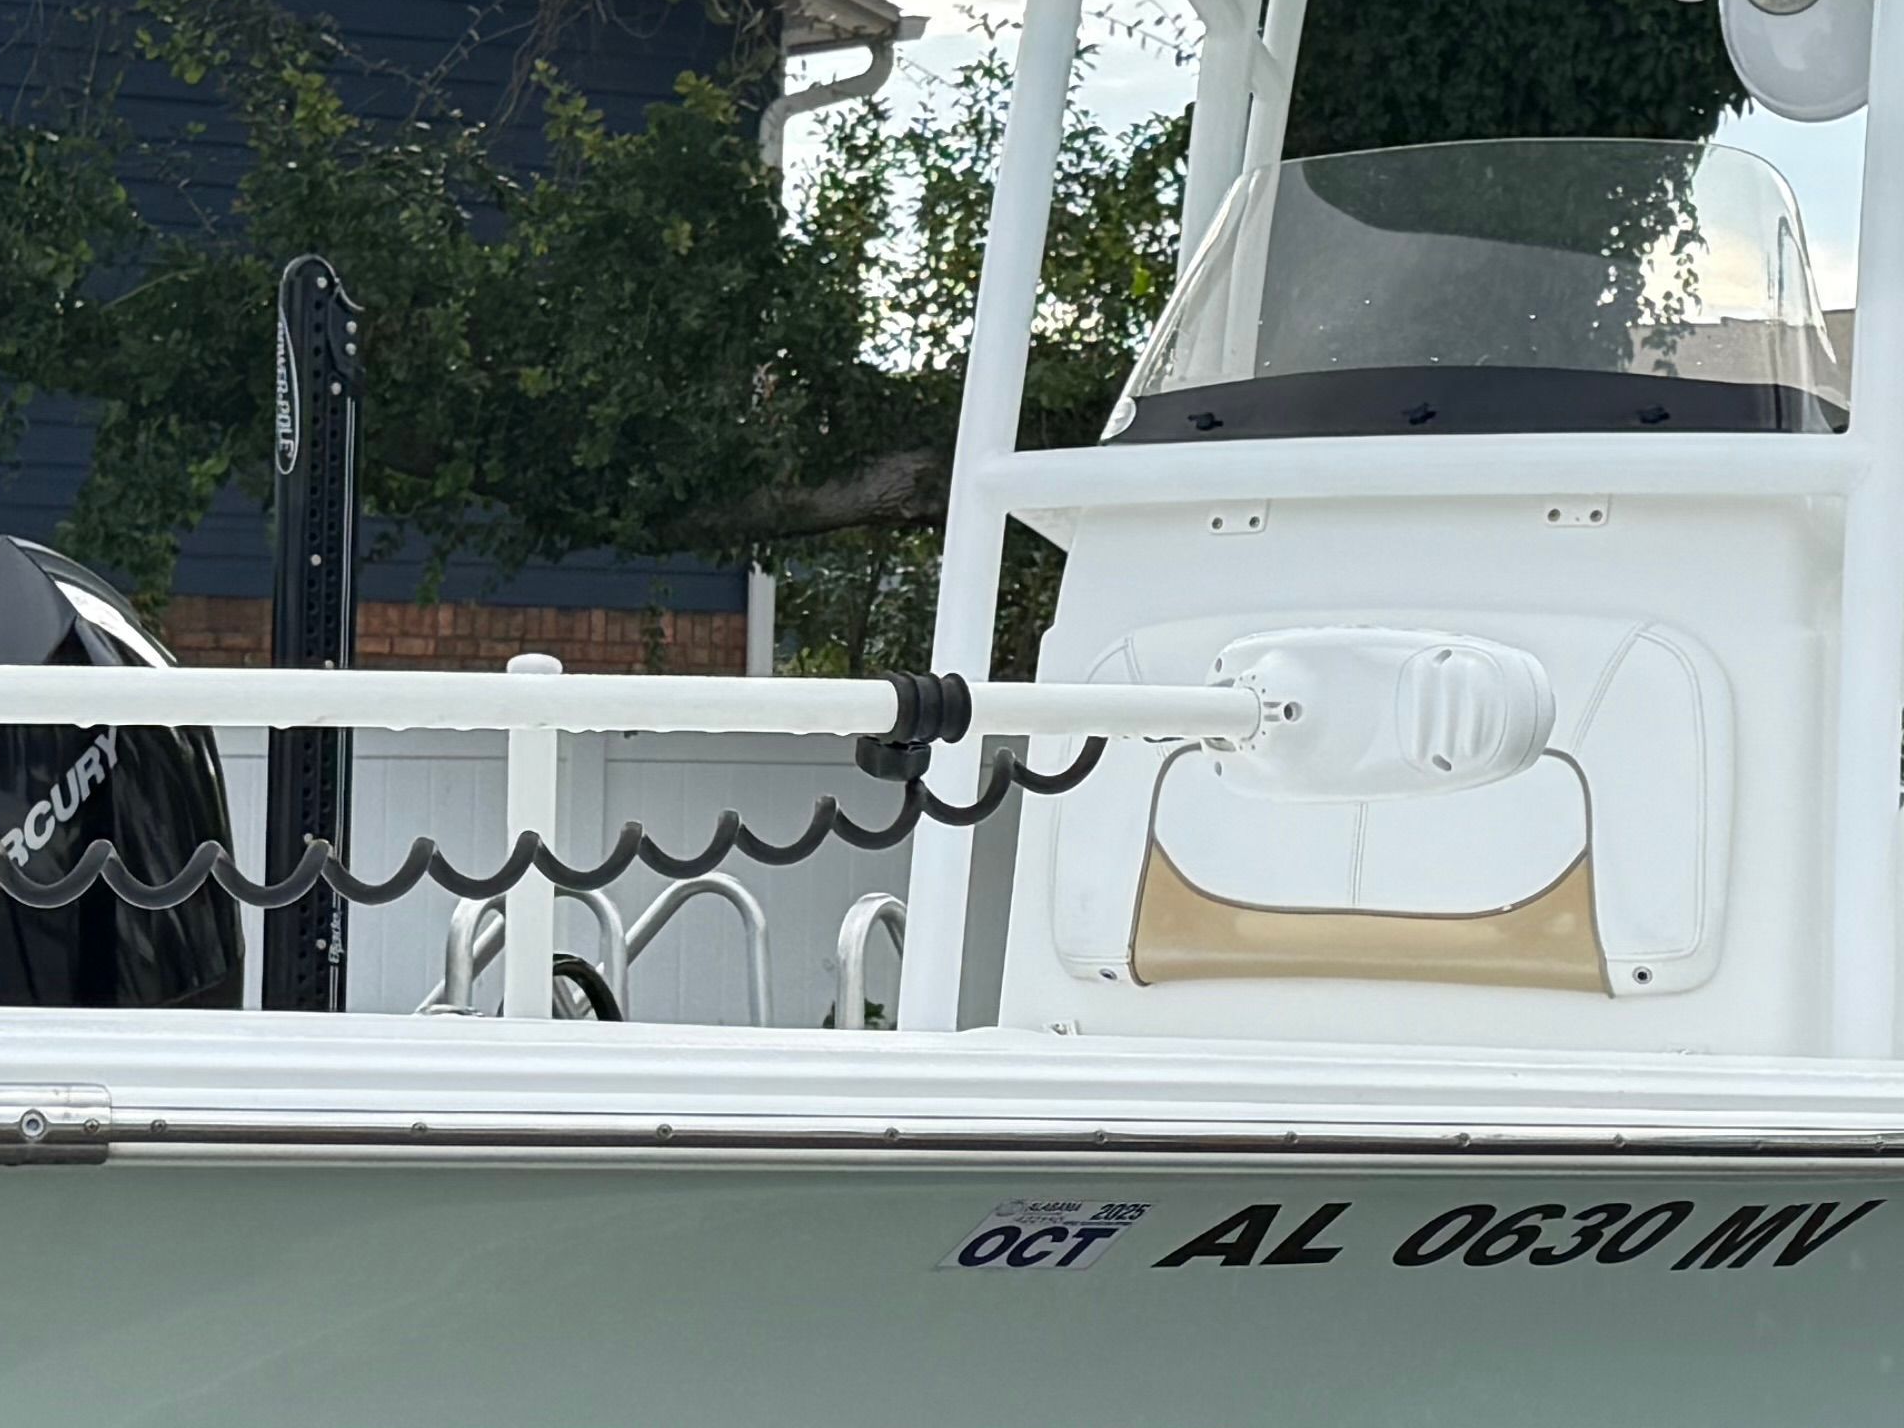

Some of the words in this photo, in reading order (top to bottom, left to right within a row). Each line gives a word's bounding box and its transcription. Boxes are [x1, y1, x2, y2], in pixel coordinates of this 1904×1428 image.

[1090, 1203, 1151, 1221] 2025
[958, 1225, 1119, 1267] OCT
[1151, 1202, 1352, 1267] AL
[1392, 1201, 1695, 1267] 0630
[1669, 1199, 1888, 1271] MV
